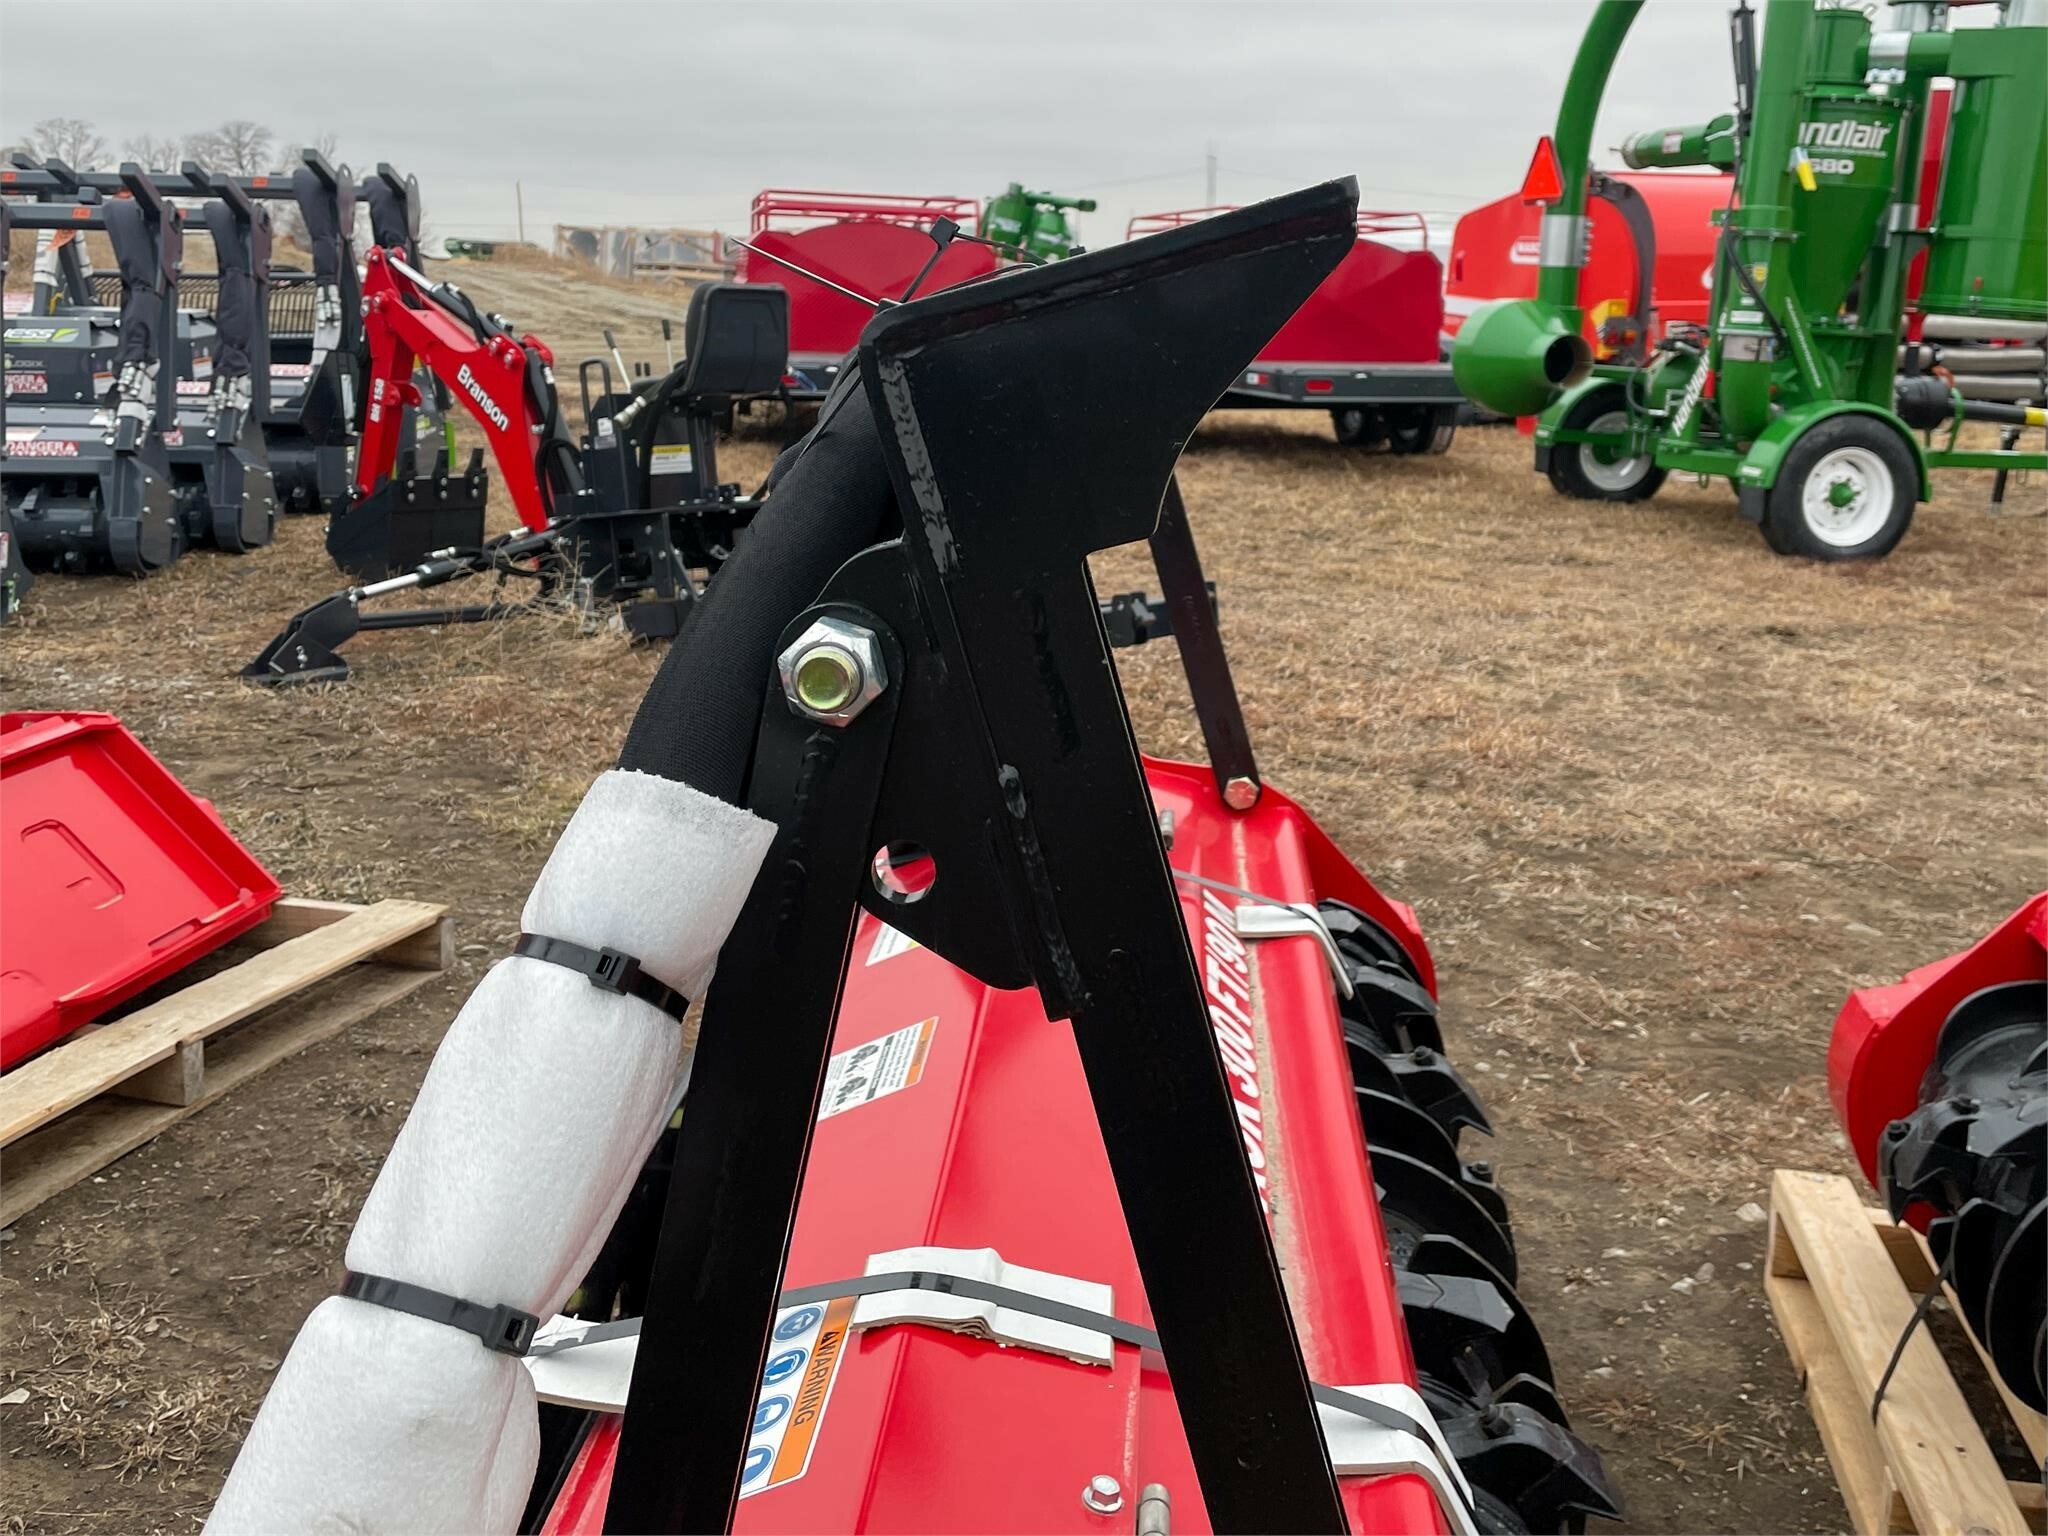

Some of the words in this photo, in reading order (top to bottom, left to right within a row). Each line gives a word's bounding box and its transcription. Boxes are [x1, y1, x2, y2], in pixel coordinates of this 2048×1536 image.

[1798, 119, 1893, 150] ndlair
[457, 364, 509, 431] Branson
[793, 1339, 838, 1427] WARNING
